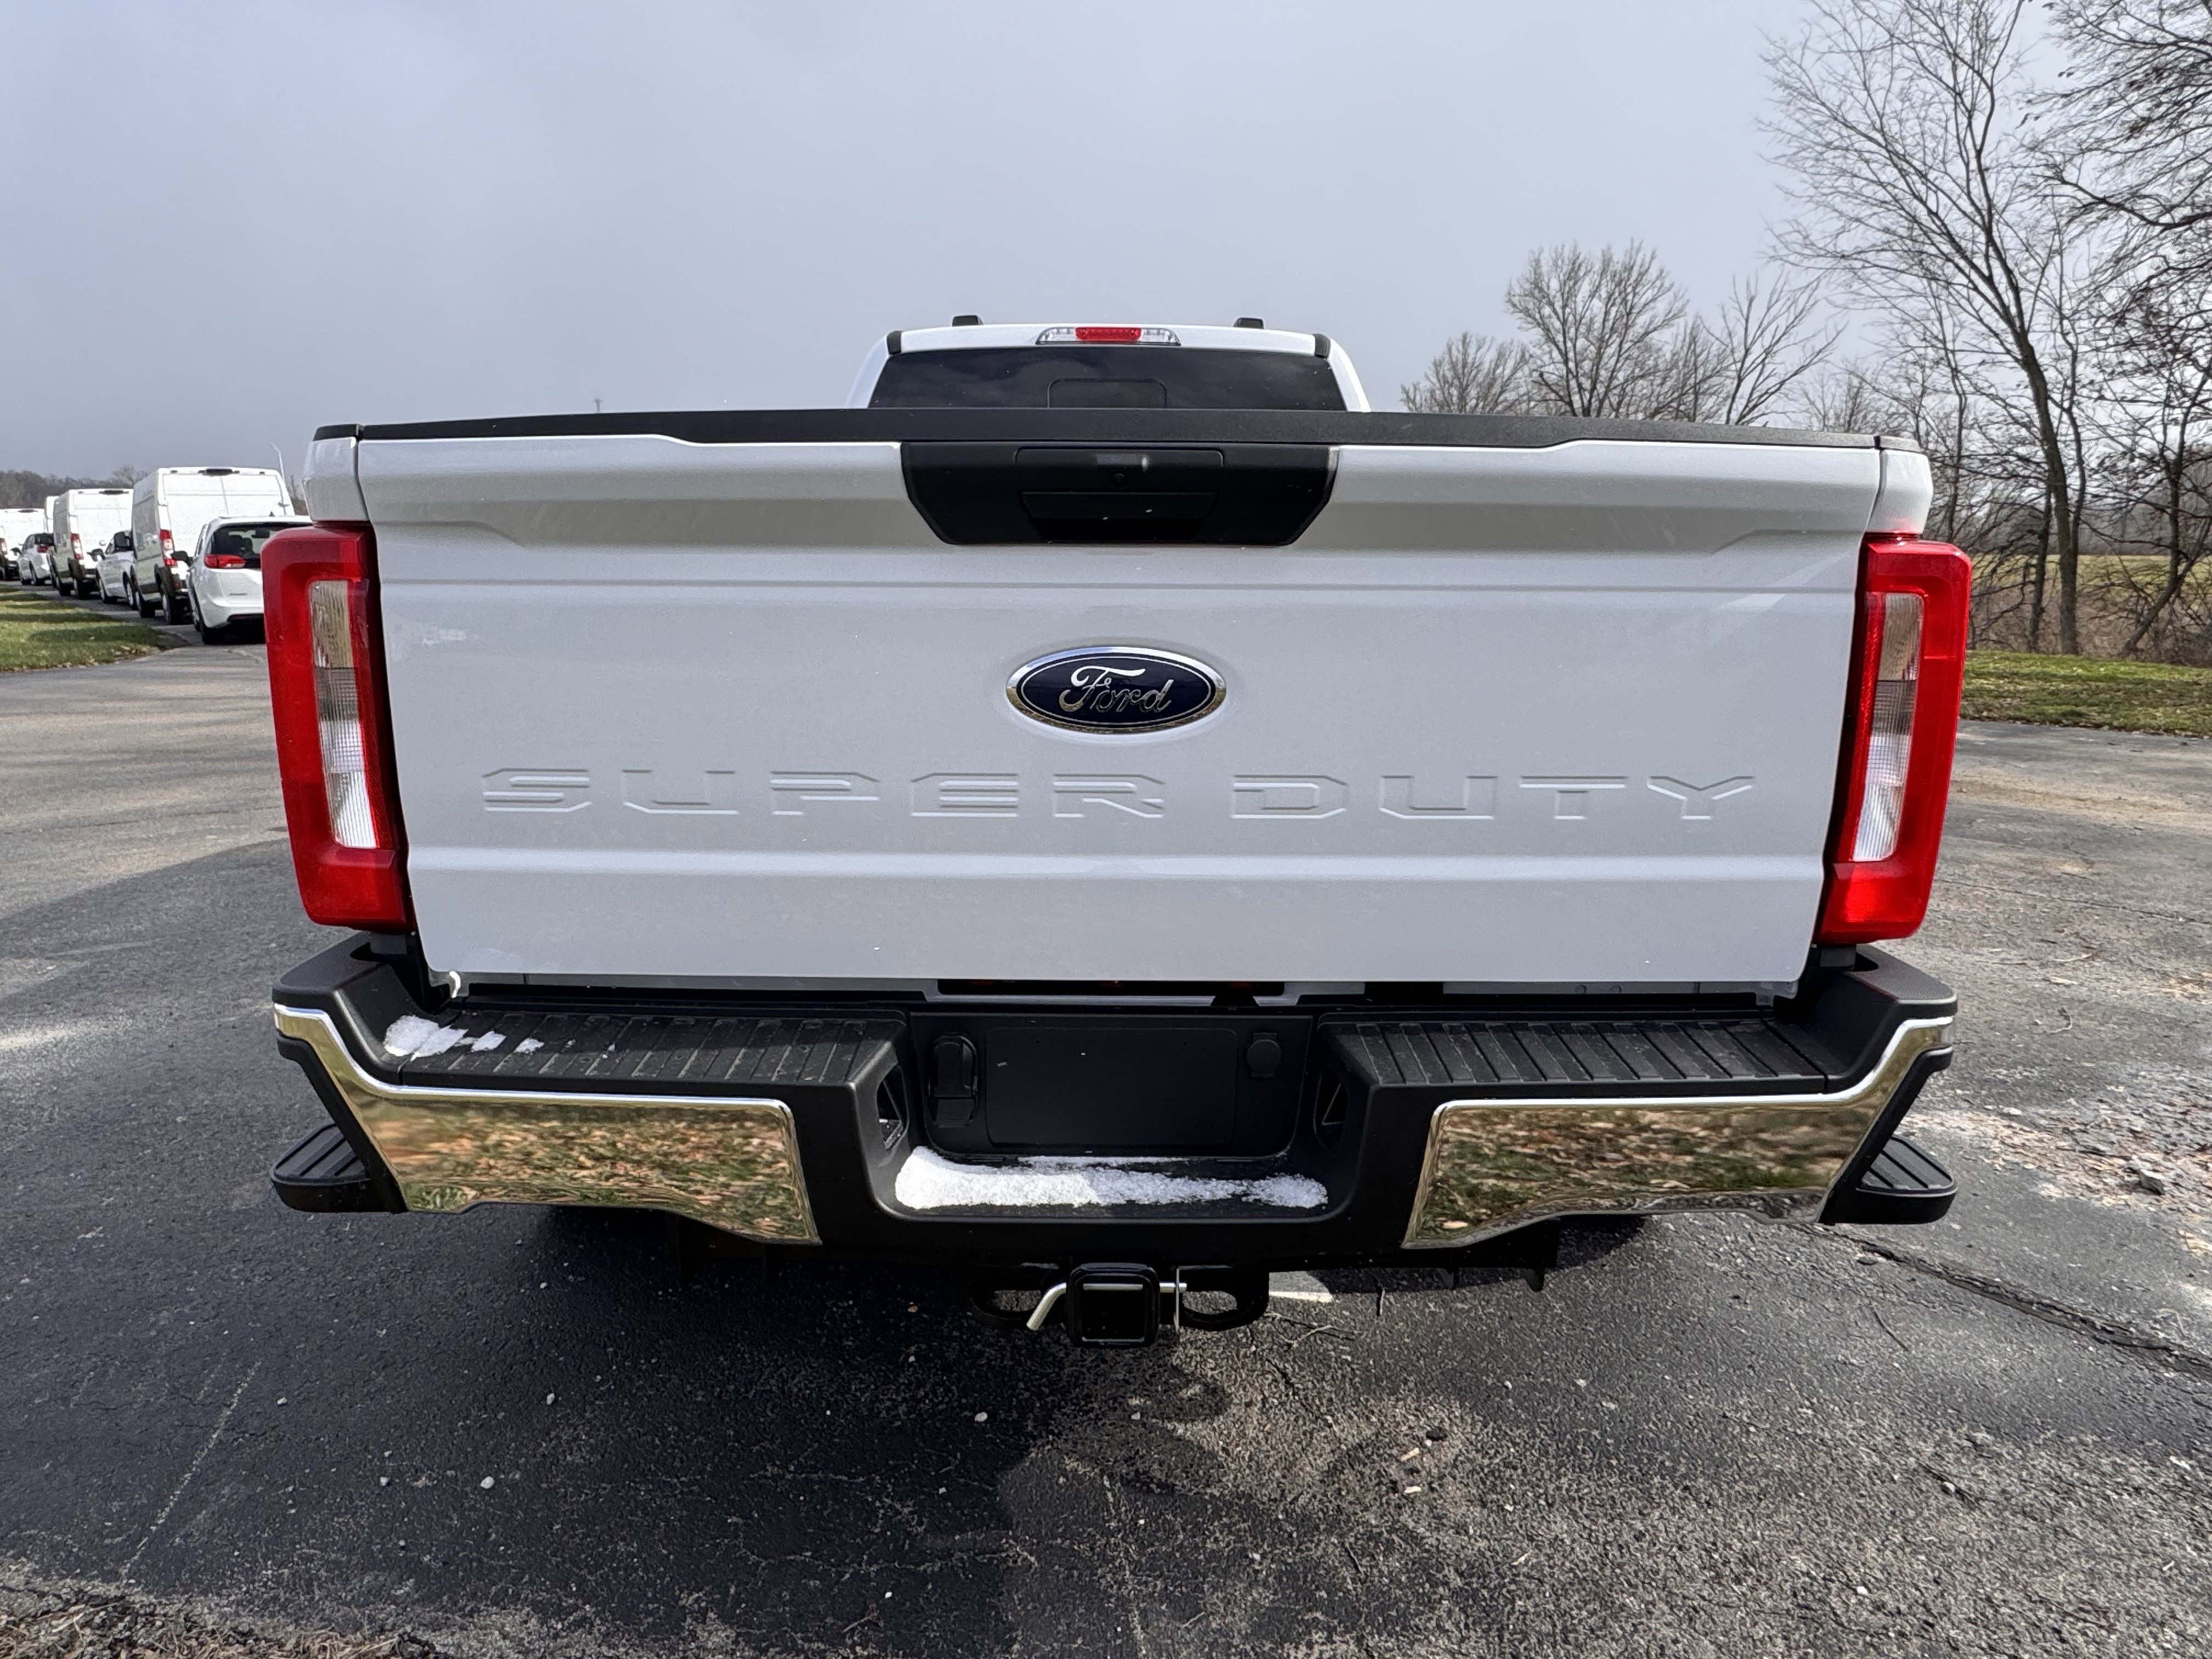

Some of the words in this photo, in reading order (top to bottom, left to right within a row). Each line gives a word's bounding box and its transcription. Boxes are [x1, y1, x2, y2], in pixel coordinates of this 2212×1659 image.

[1059, 665, 1173, 713] Ford
[481, 769, 1165, 819] SUPER
[1230, 774, 1756, 820] DUTY
